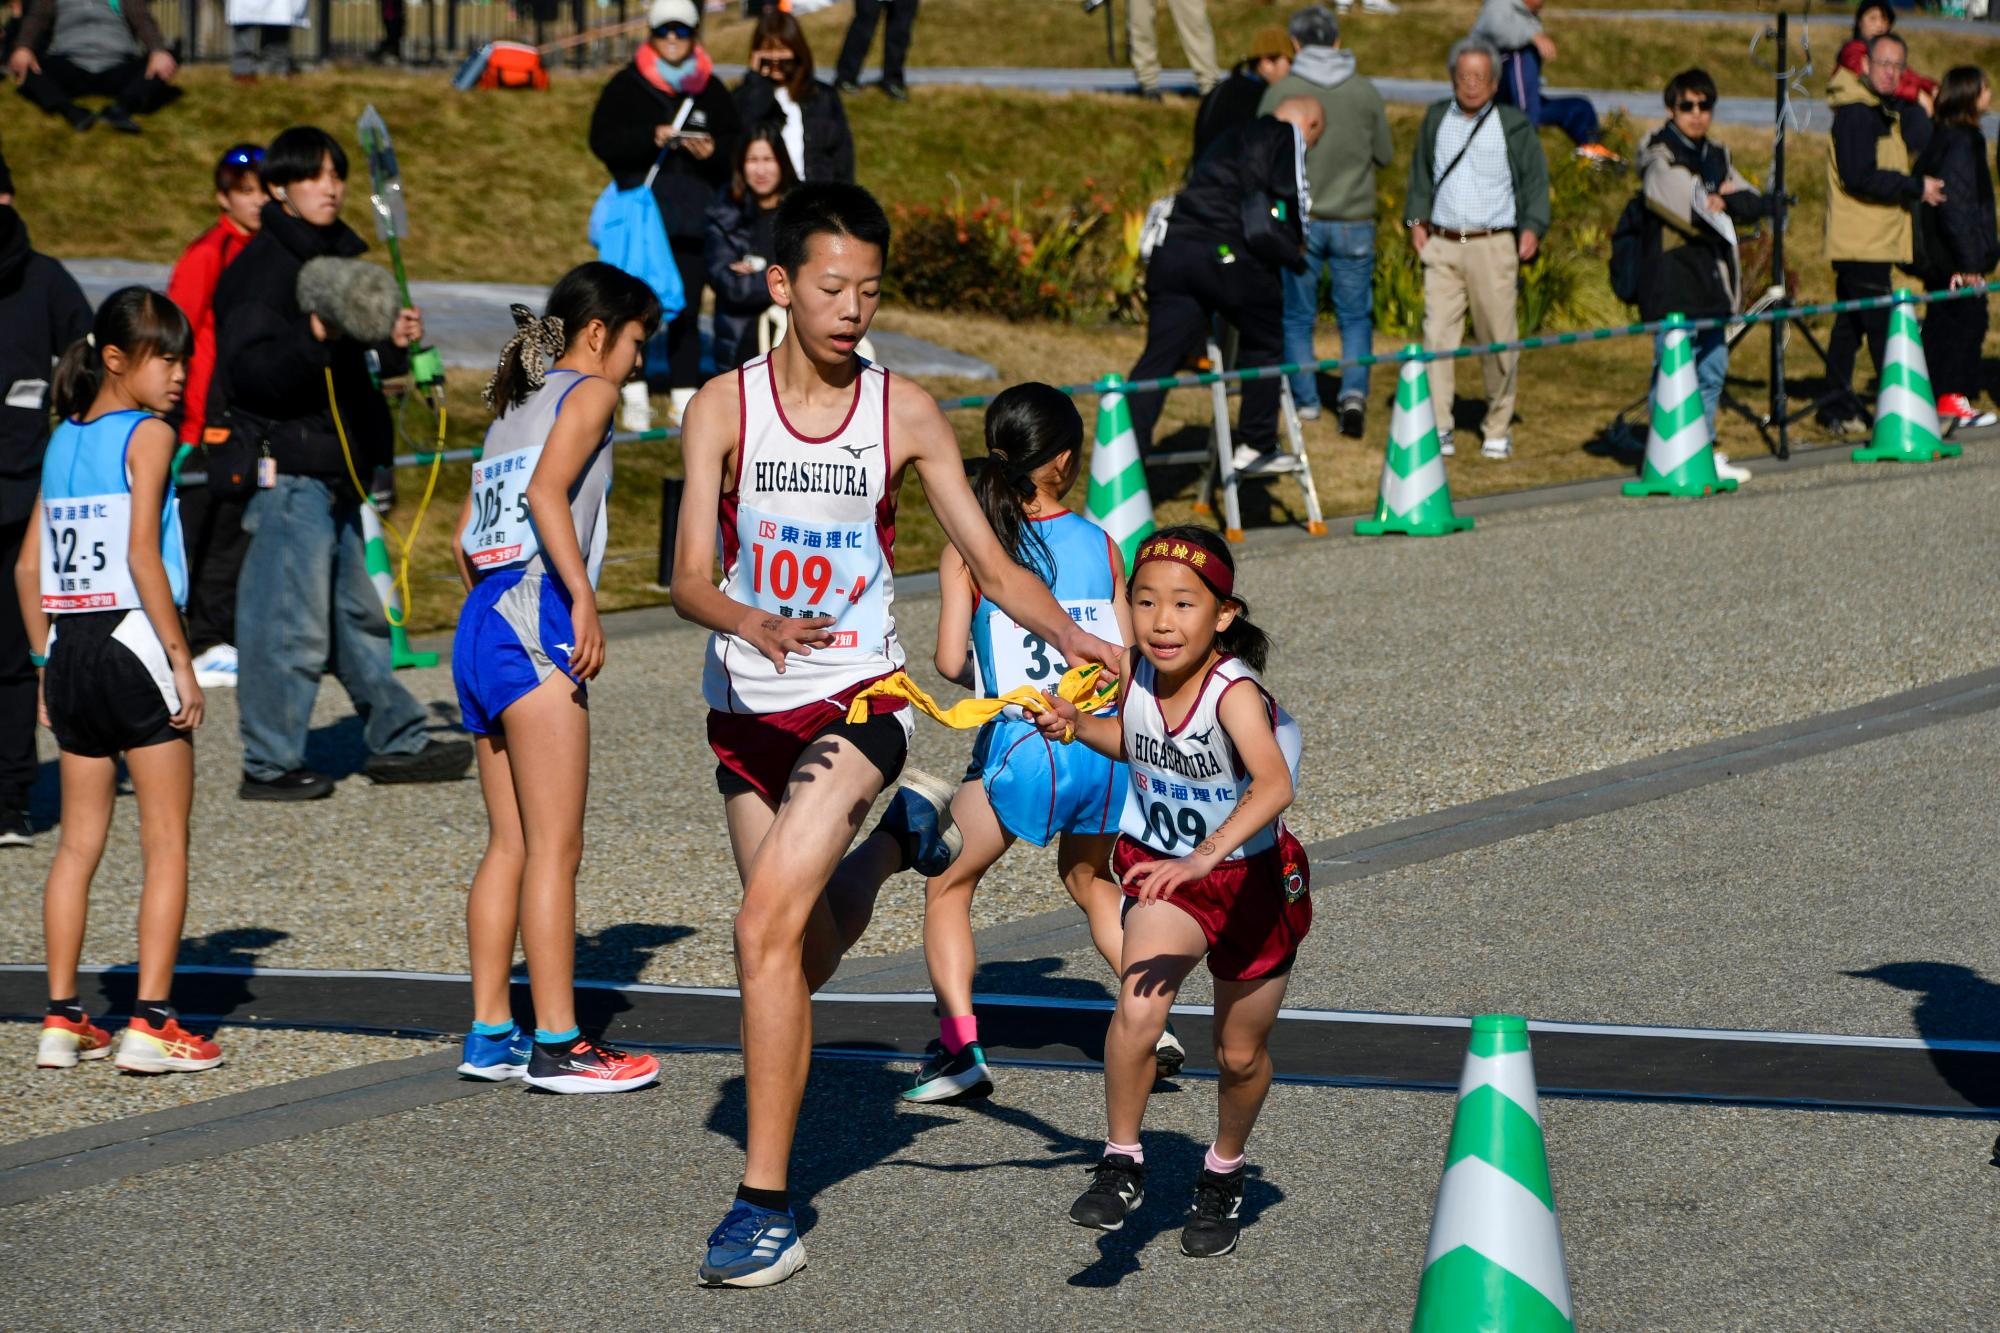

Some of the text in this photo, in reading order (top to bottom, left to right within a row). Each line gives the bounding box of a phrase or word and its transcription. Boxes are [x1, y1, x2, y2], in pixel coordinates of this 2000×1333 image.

[755, 461, 868, 497] HIGASHIURA
[781, 525, 863, 549] 東海理化
[752, 543, 866, 605] 109-4
[1135, 732, 1222, 779] HIGASHIURA
[1151, 778, 1236, 803] 東海理化
